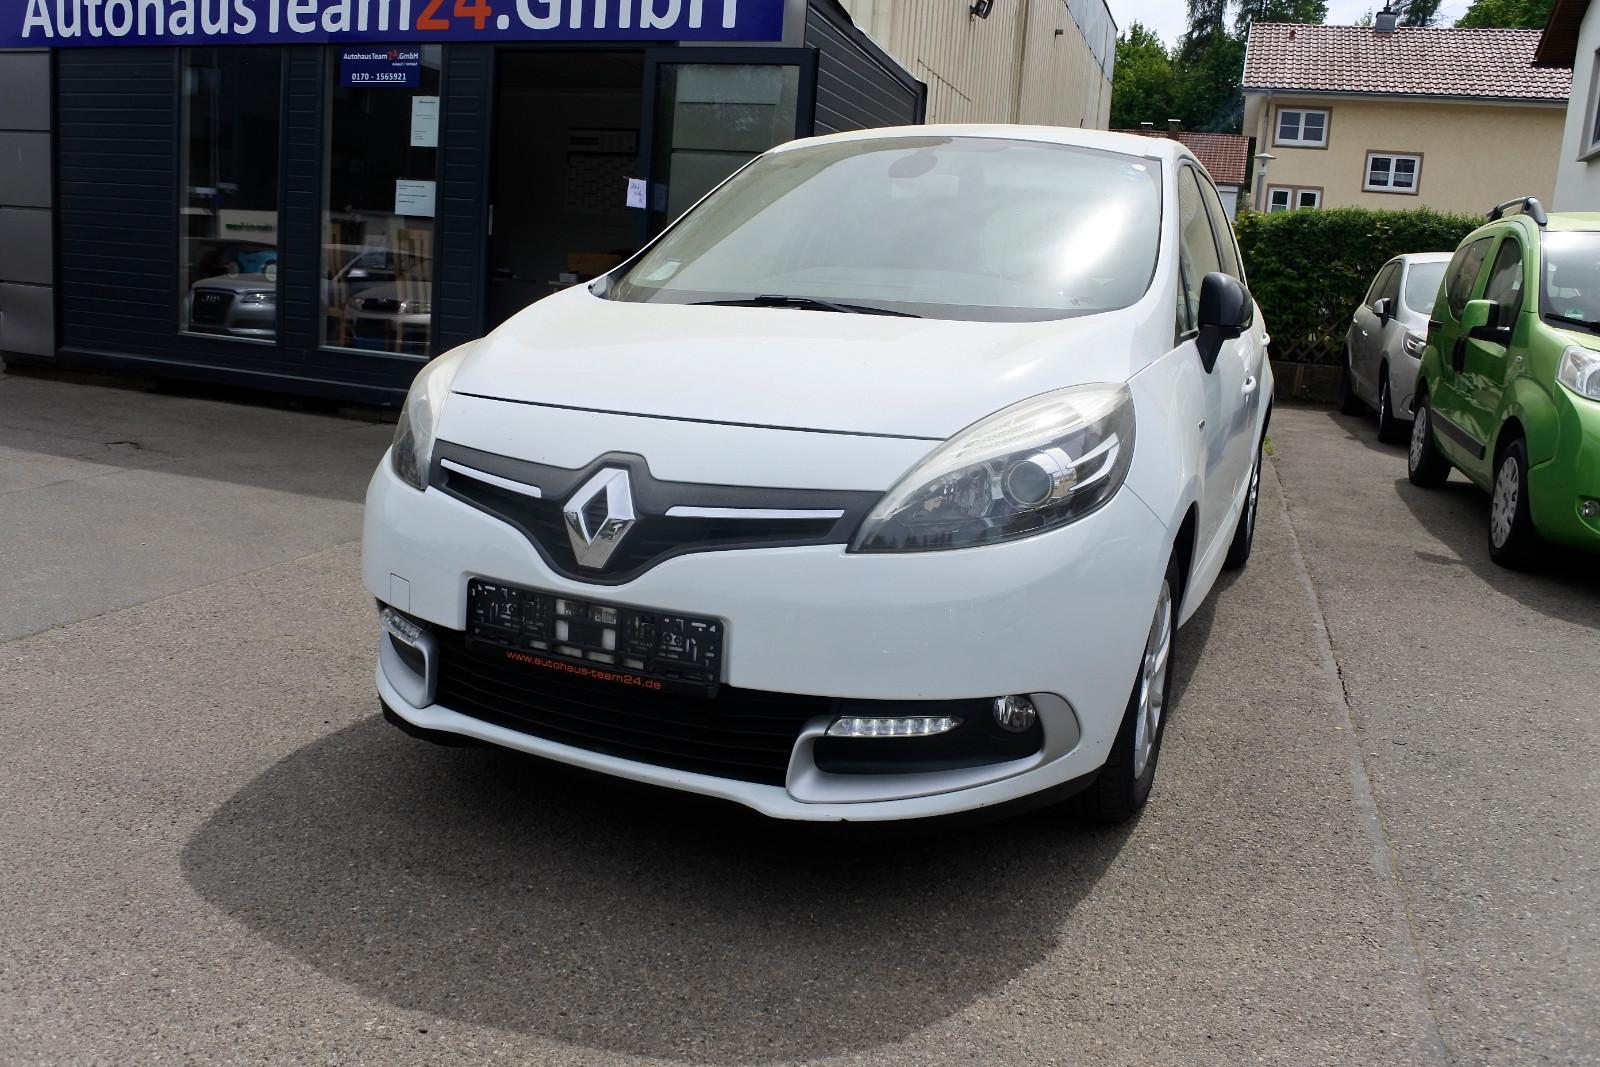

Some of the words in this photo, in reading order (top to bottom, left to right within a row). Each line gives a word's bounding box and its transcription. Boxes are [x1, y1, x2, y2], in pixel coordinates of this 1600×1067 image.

[351, 73, 370, 81] 0170
[376, 73, 407, 81] 1565921
[506, 651, 662, 690] www.autohaus-team24.de
